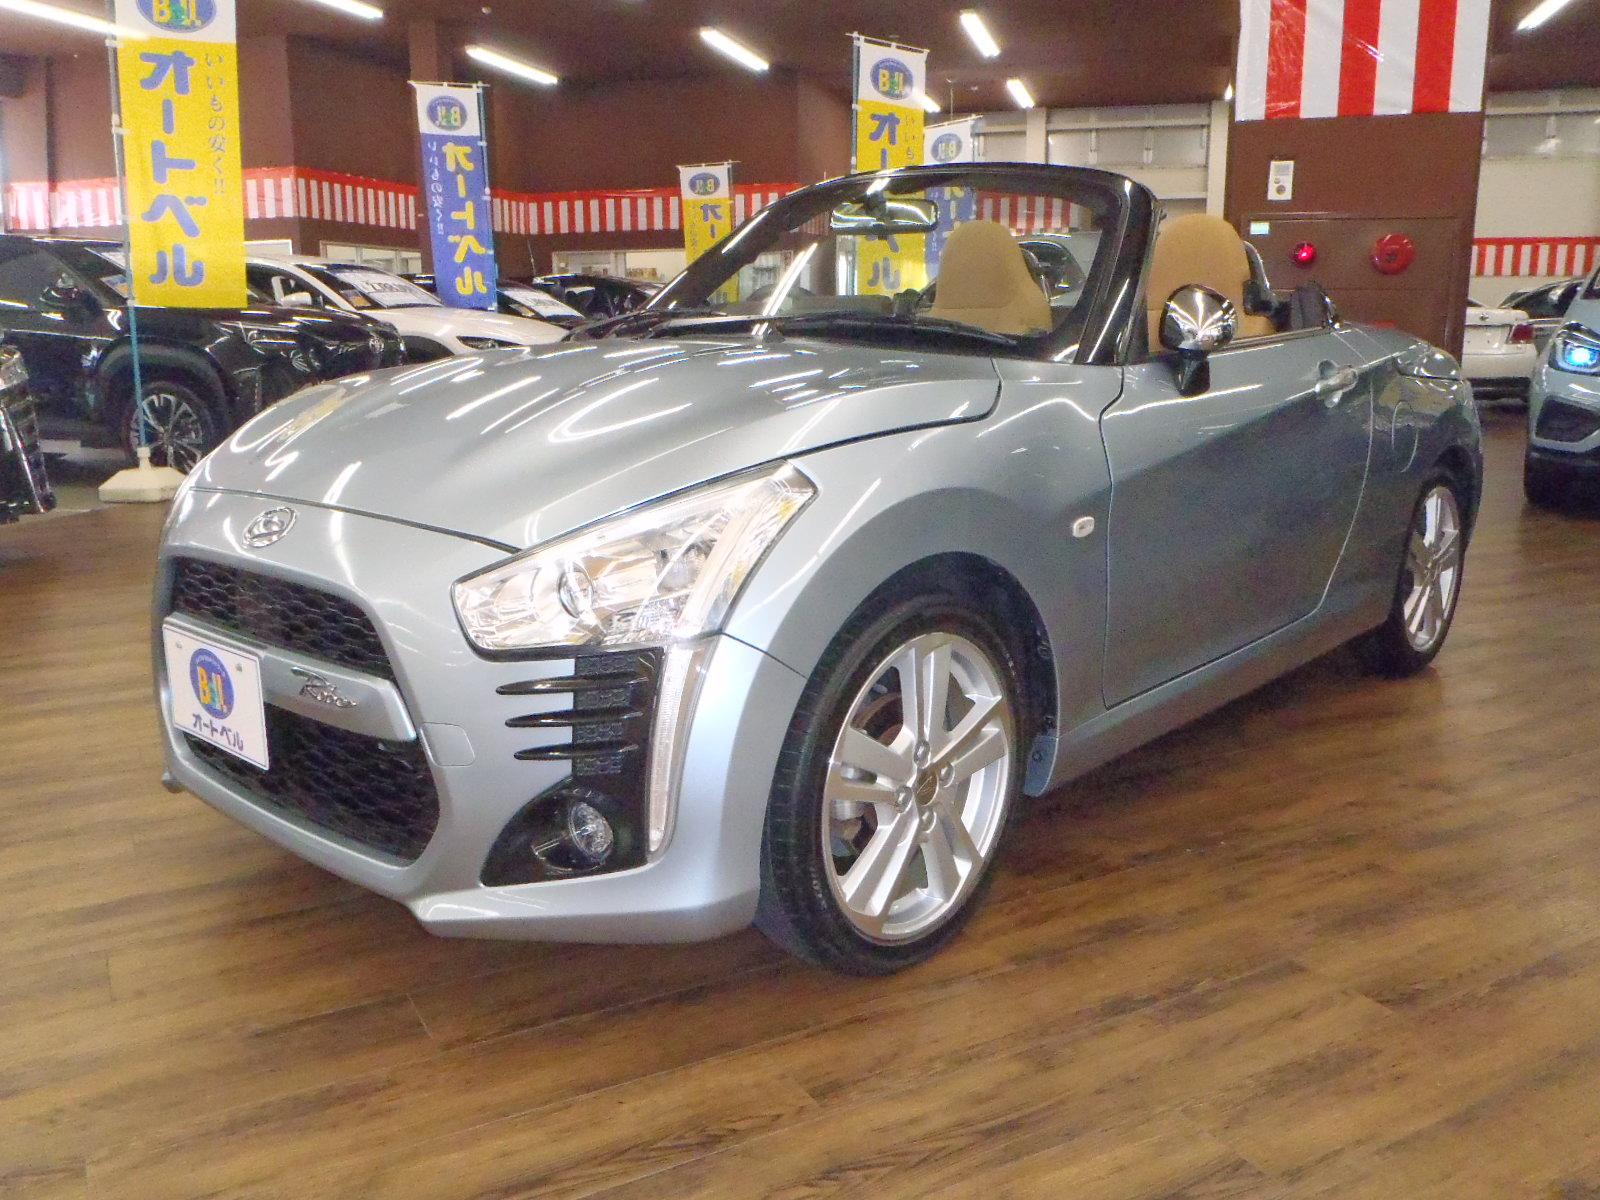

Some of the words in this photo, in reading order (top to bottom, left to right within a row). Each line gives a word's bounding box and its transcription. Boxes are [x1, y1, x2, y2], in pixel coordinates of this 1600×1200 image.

[139, 50, 208, 287] オートベル
[192, 713, 244, 751] オートベル
